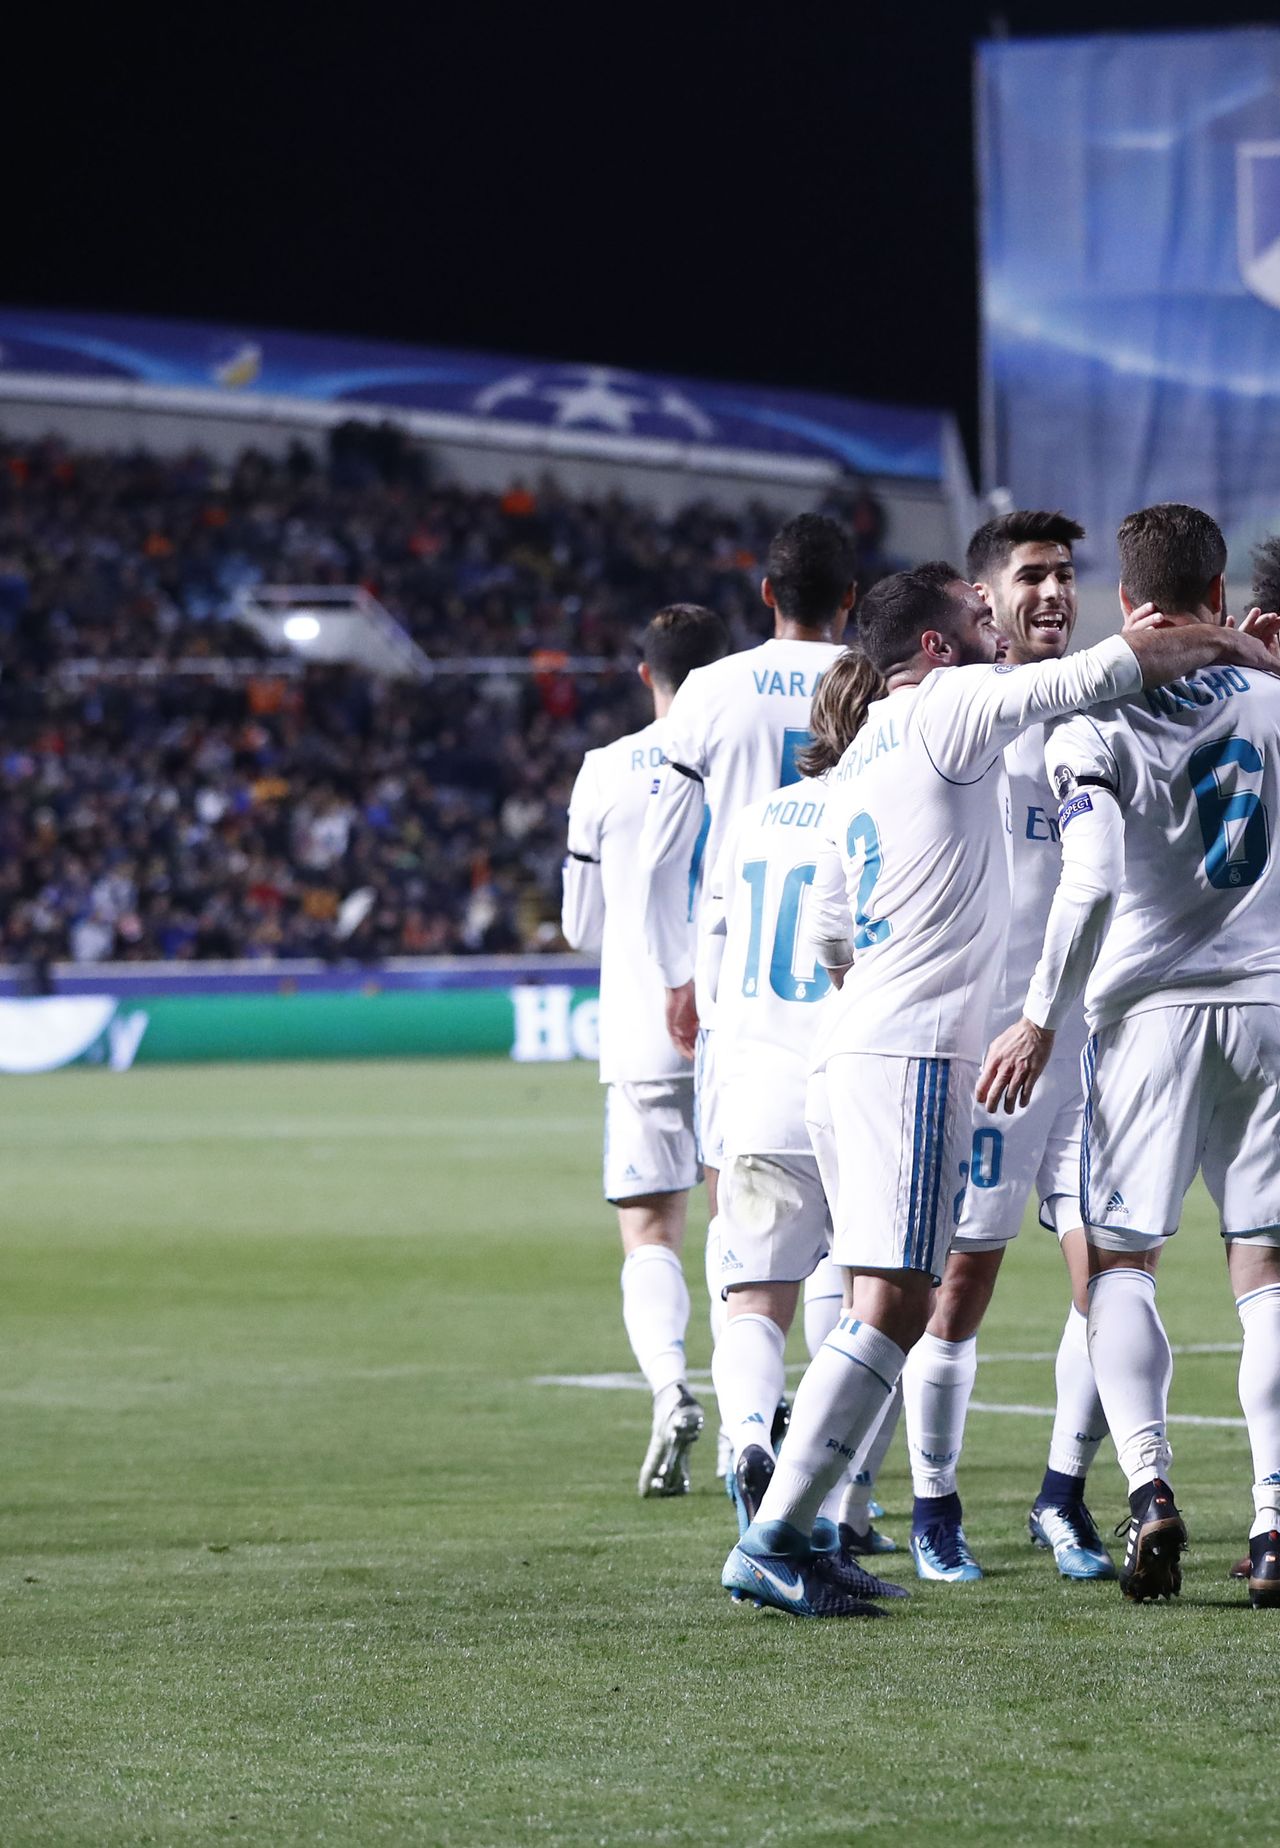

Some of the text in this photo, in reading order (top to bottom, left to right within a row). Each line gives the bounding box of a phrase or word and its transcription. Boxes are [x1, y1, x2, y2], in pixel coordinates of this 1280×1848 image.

[847, 808, 893, 950] 2
[1188, 735, 1272, 889] 6
[742, 856, 834, 1003] 10
